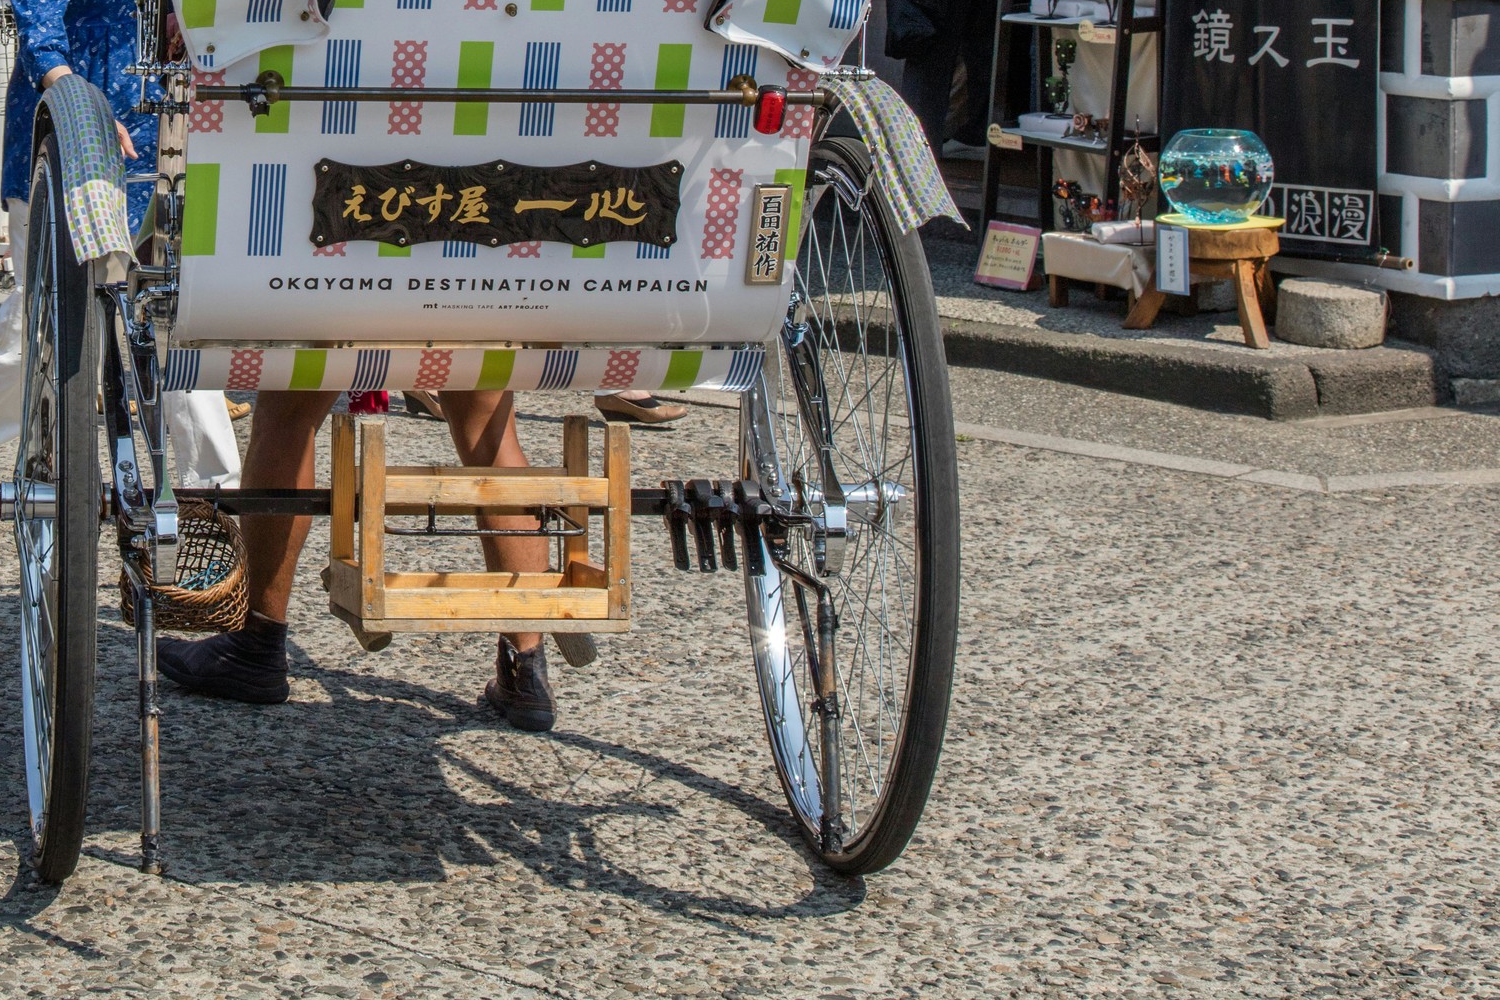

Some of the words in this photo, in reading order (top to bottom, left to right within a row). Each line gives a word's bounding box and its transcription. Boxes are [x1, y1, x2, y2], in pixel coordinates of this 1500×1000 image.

[342, 183, 491, 225] えびす屋
[754, 195, 783, 277] 百田祐作
[408, 278, 571, 292] DESTINATION
[583, 279, 708, 293] CAMPAIGN
